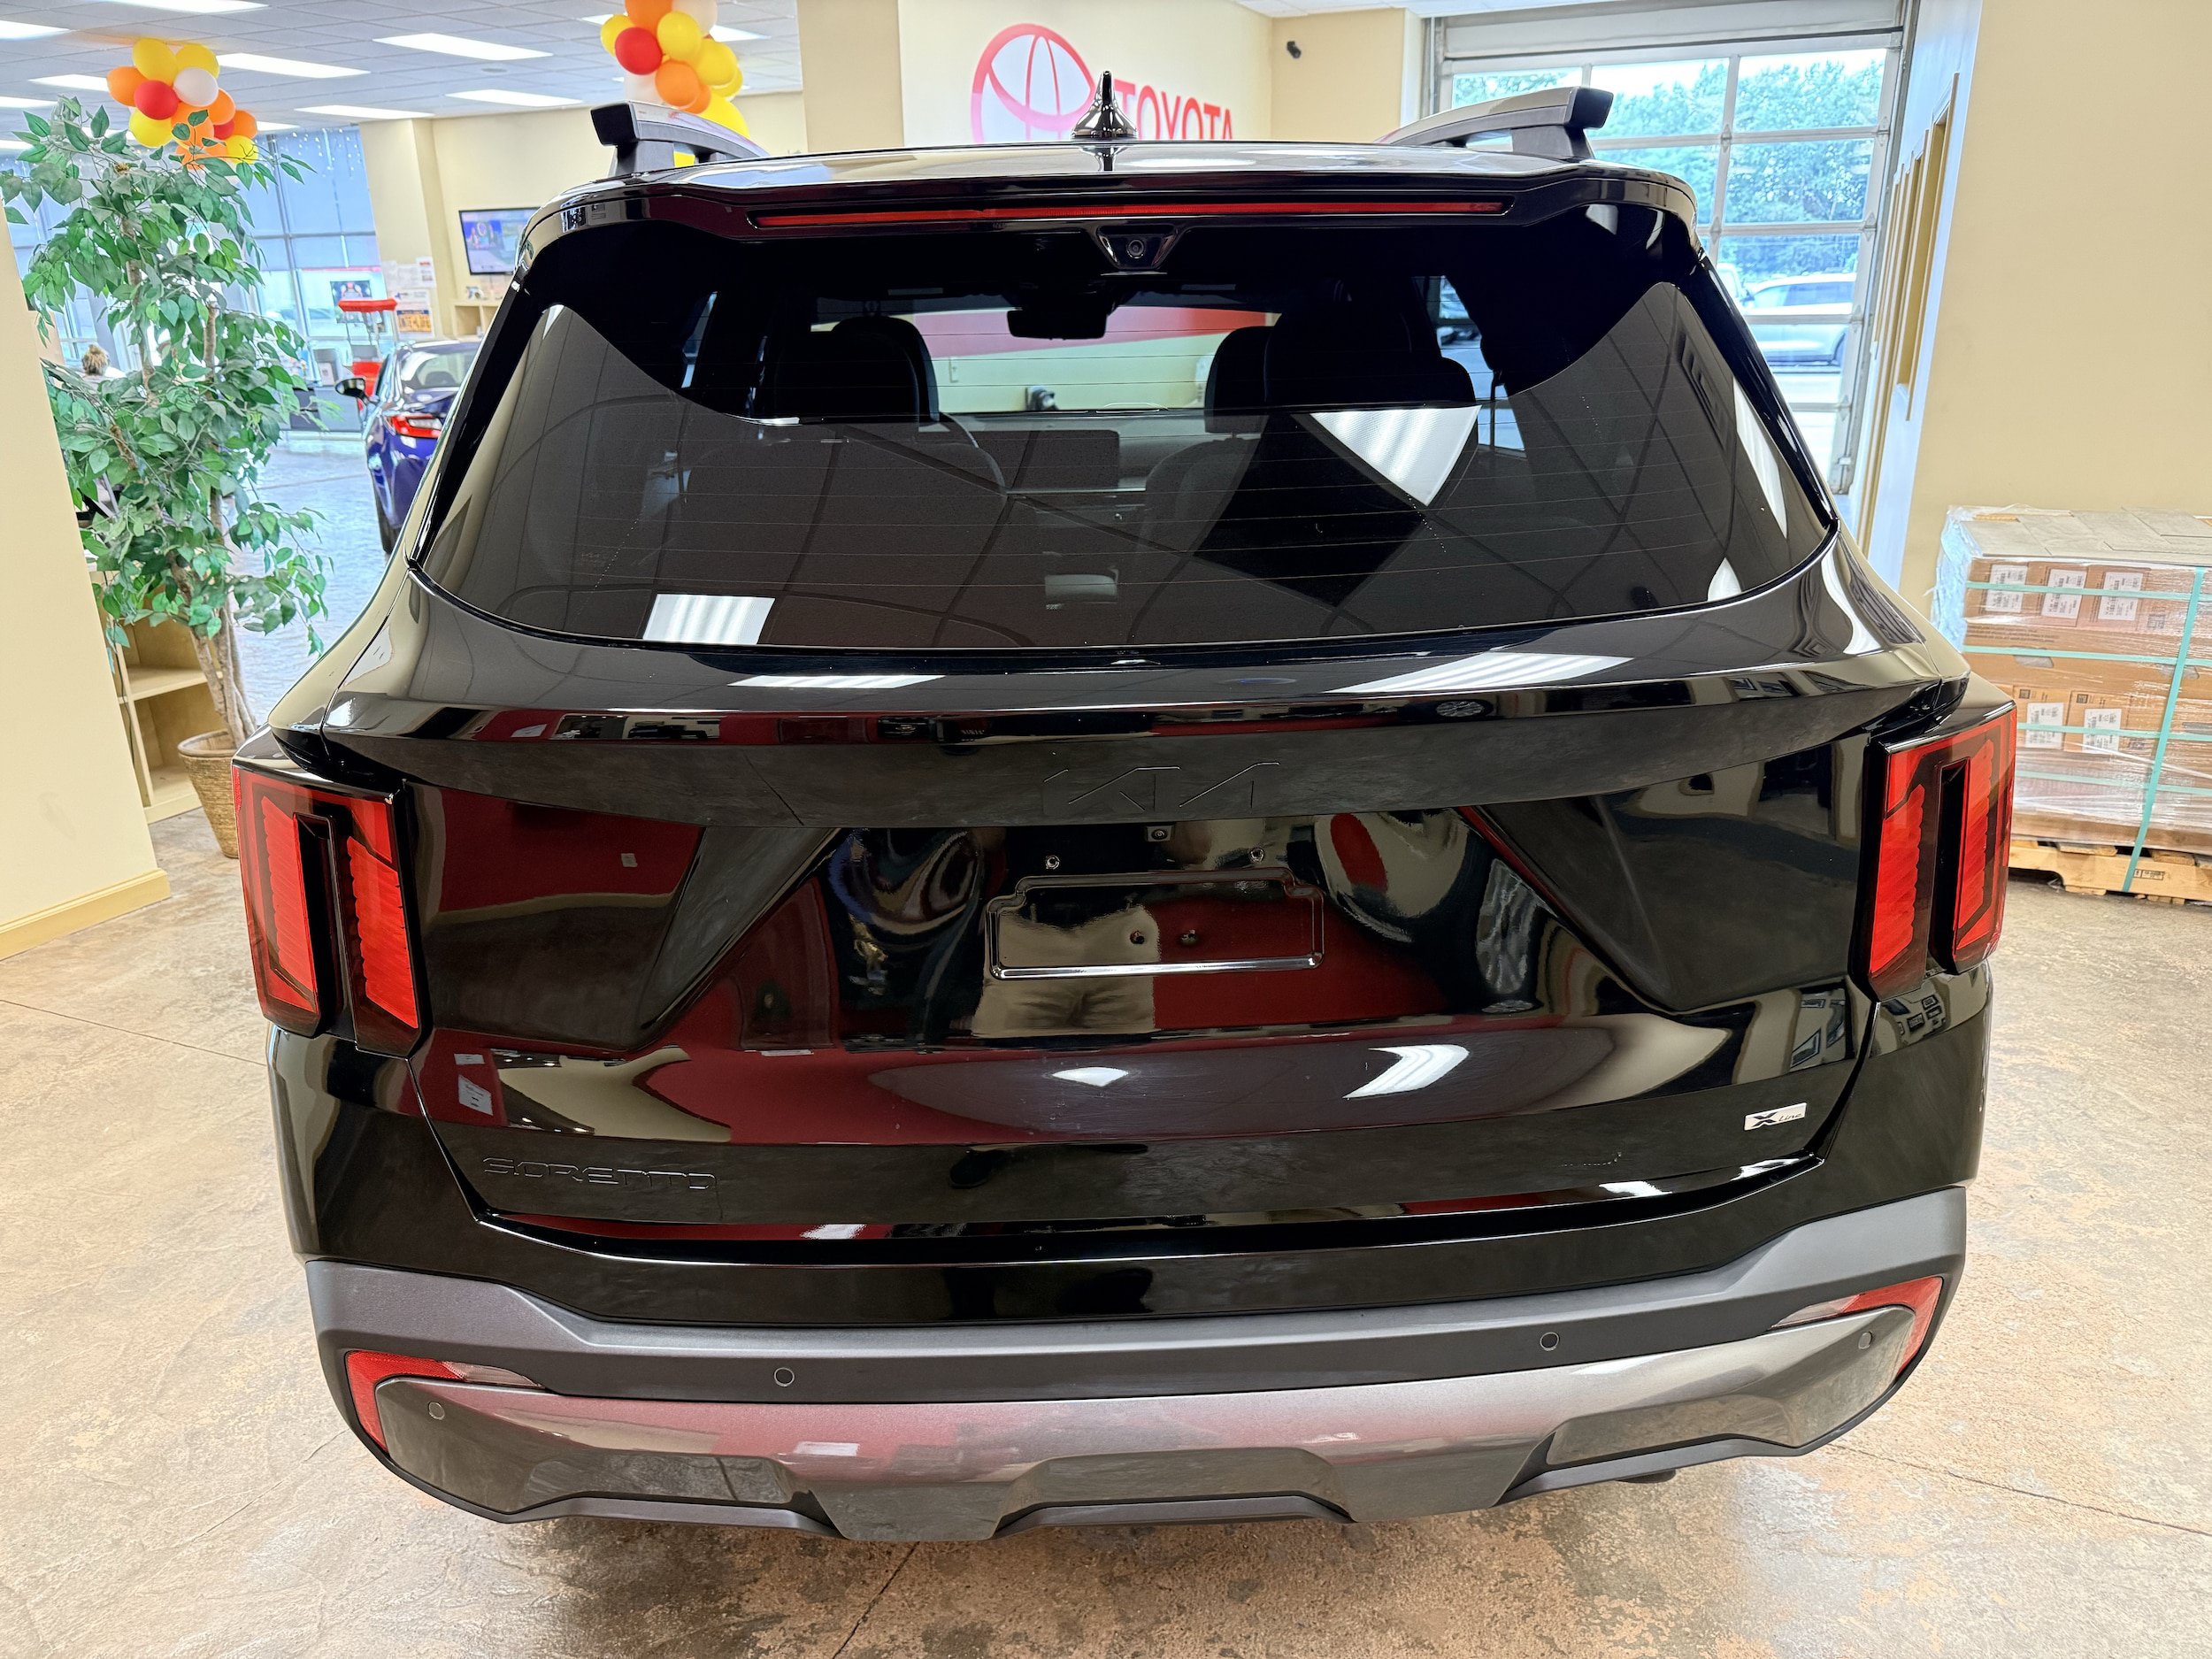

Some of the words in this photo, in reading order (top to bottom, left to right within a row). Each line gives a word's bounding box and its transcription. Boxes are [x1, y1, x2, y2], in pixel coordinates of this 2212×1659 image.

[1114, 79, 1233, 140] TOYOTA
[1041, 762, 1280, 815] KIA
[482, 1157, 717, 1191] SORENTO
